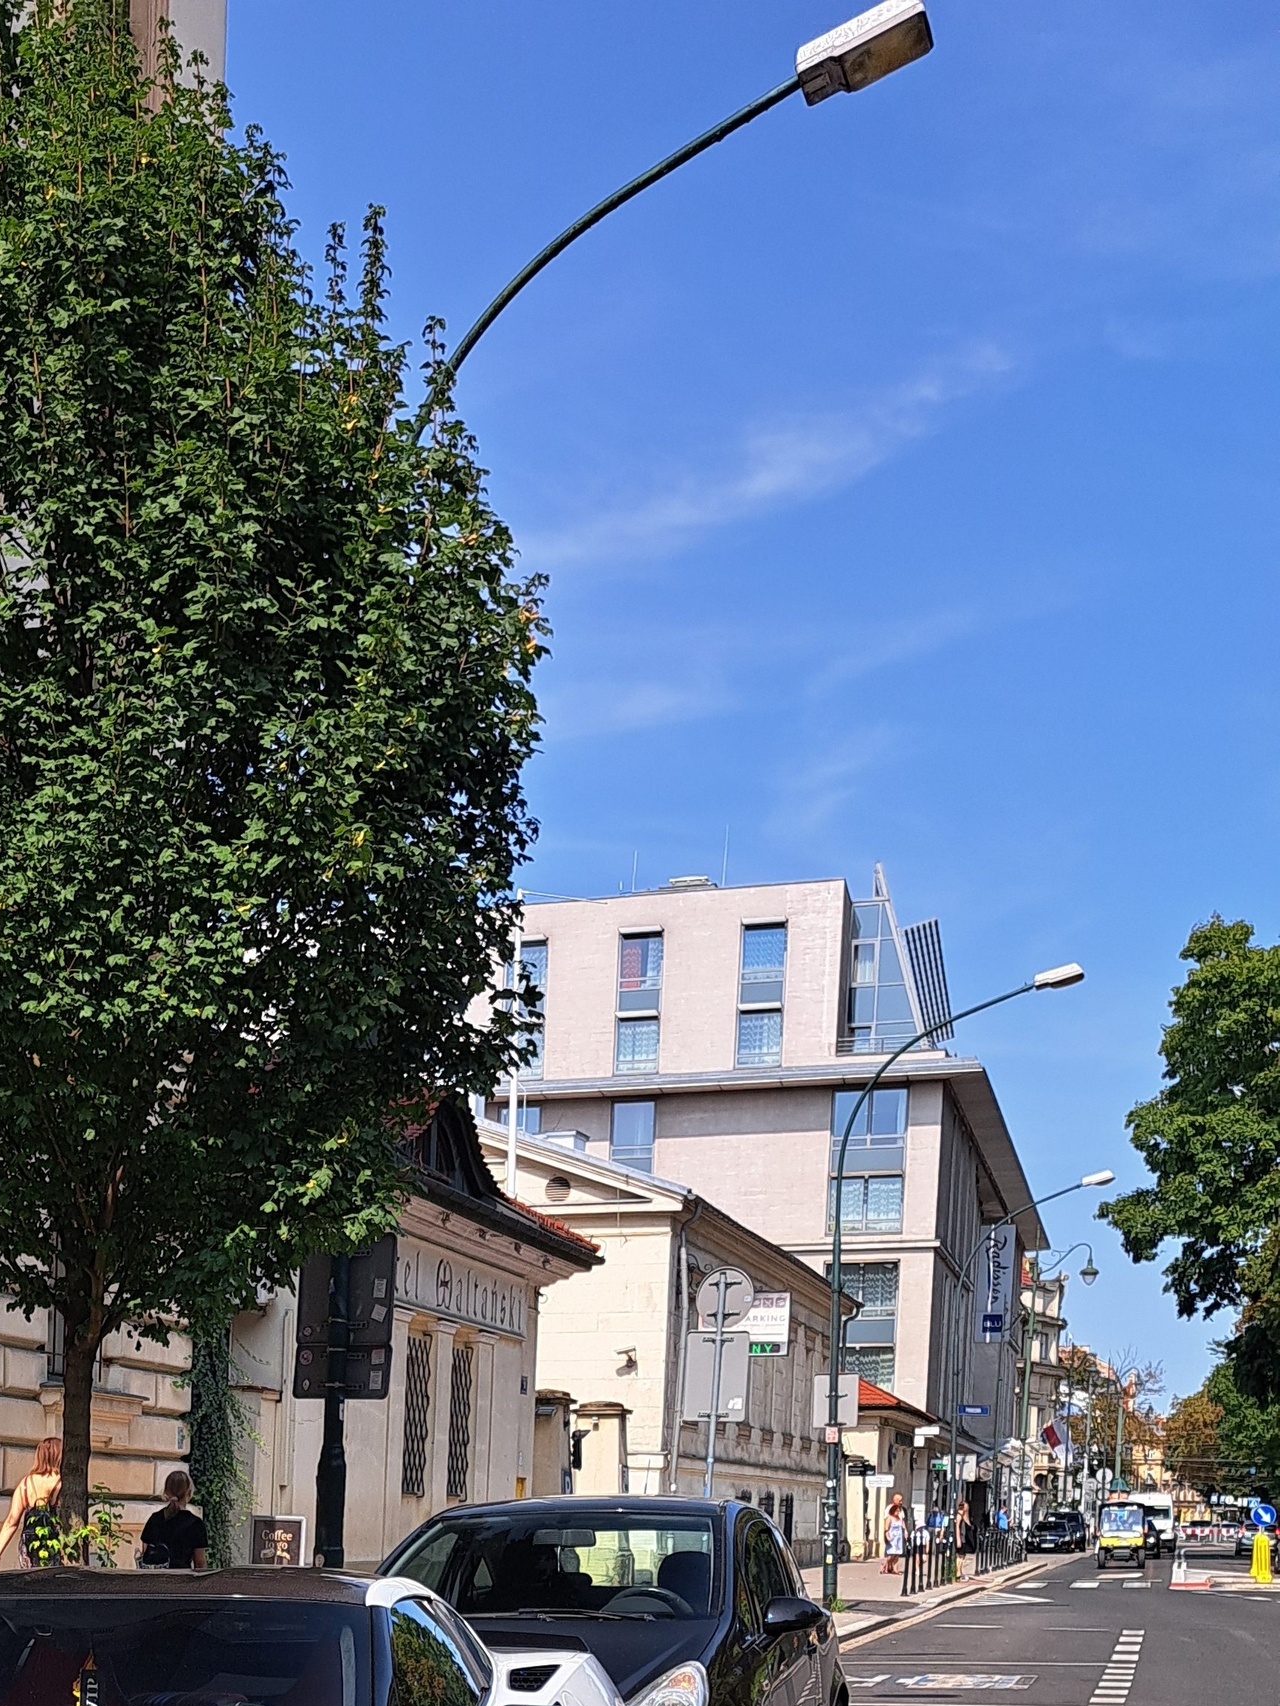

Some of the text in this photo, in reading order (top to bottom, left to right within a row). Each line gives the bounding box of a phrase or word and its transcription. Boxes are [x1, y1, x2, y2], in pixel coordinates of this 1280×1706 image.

[986, 1235, 1010, 1305] Radisson
[435, 1258, 523, 1331] Maltański
[744, 1314, 786, 1323] ARKING
[751, 1343, 773, 1354] NY
[261, 1529, 293, 1541] Coffee
[265, 1540, 289, 1551] to go
